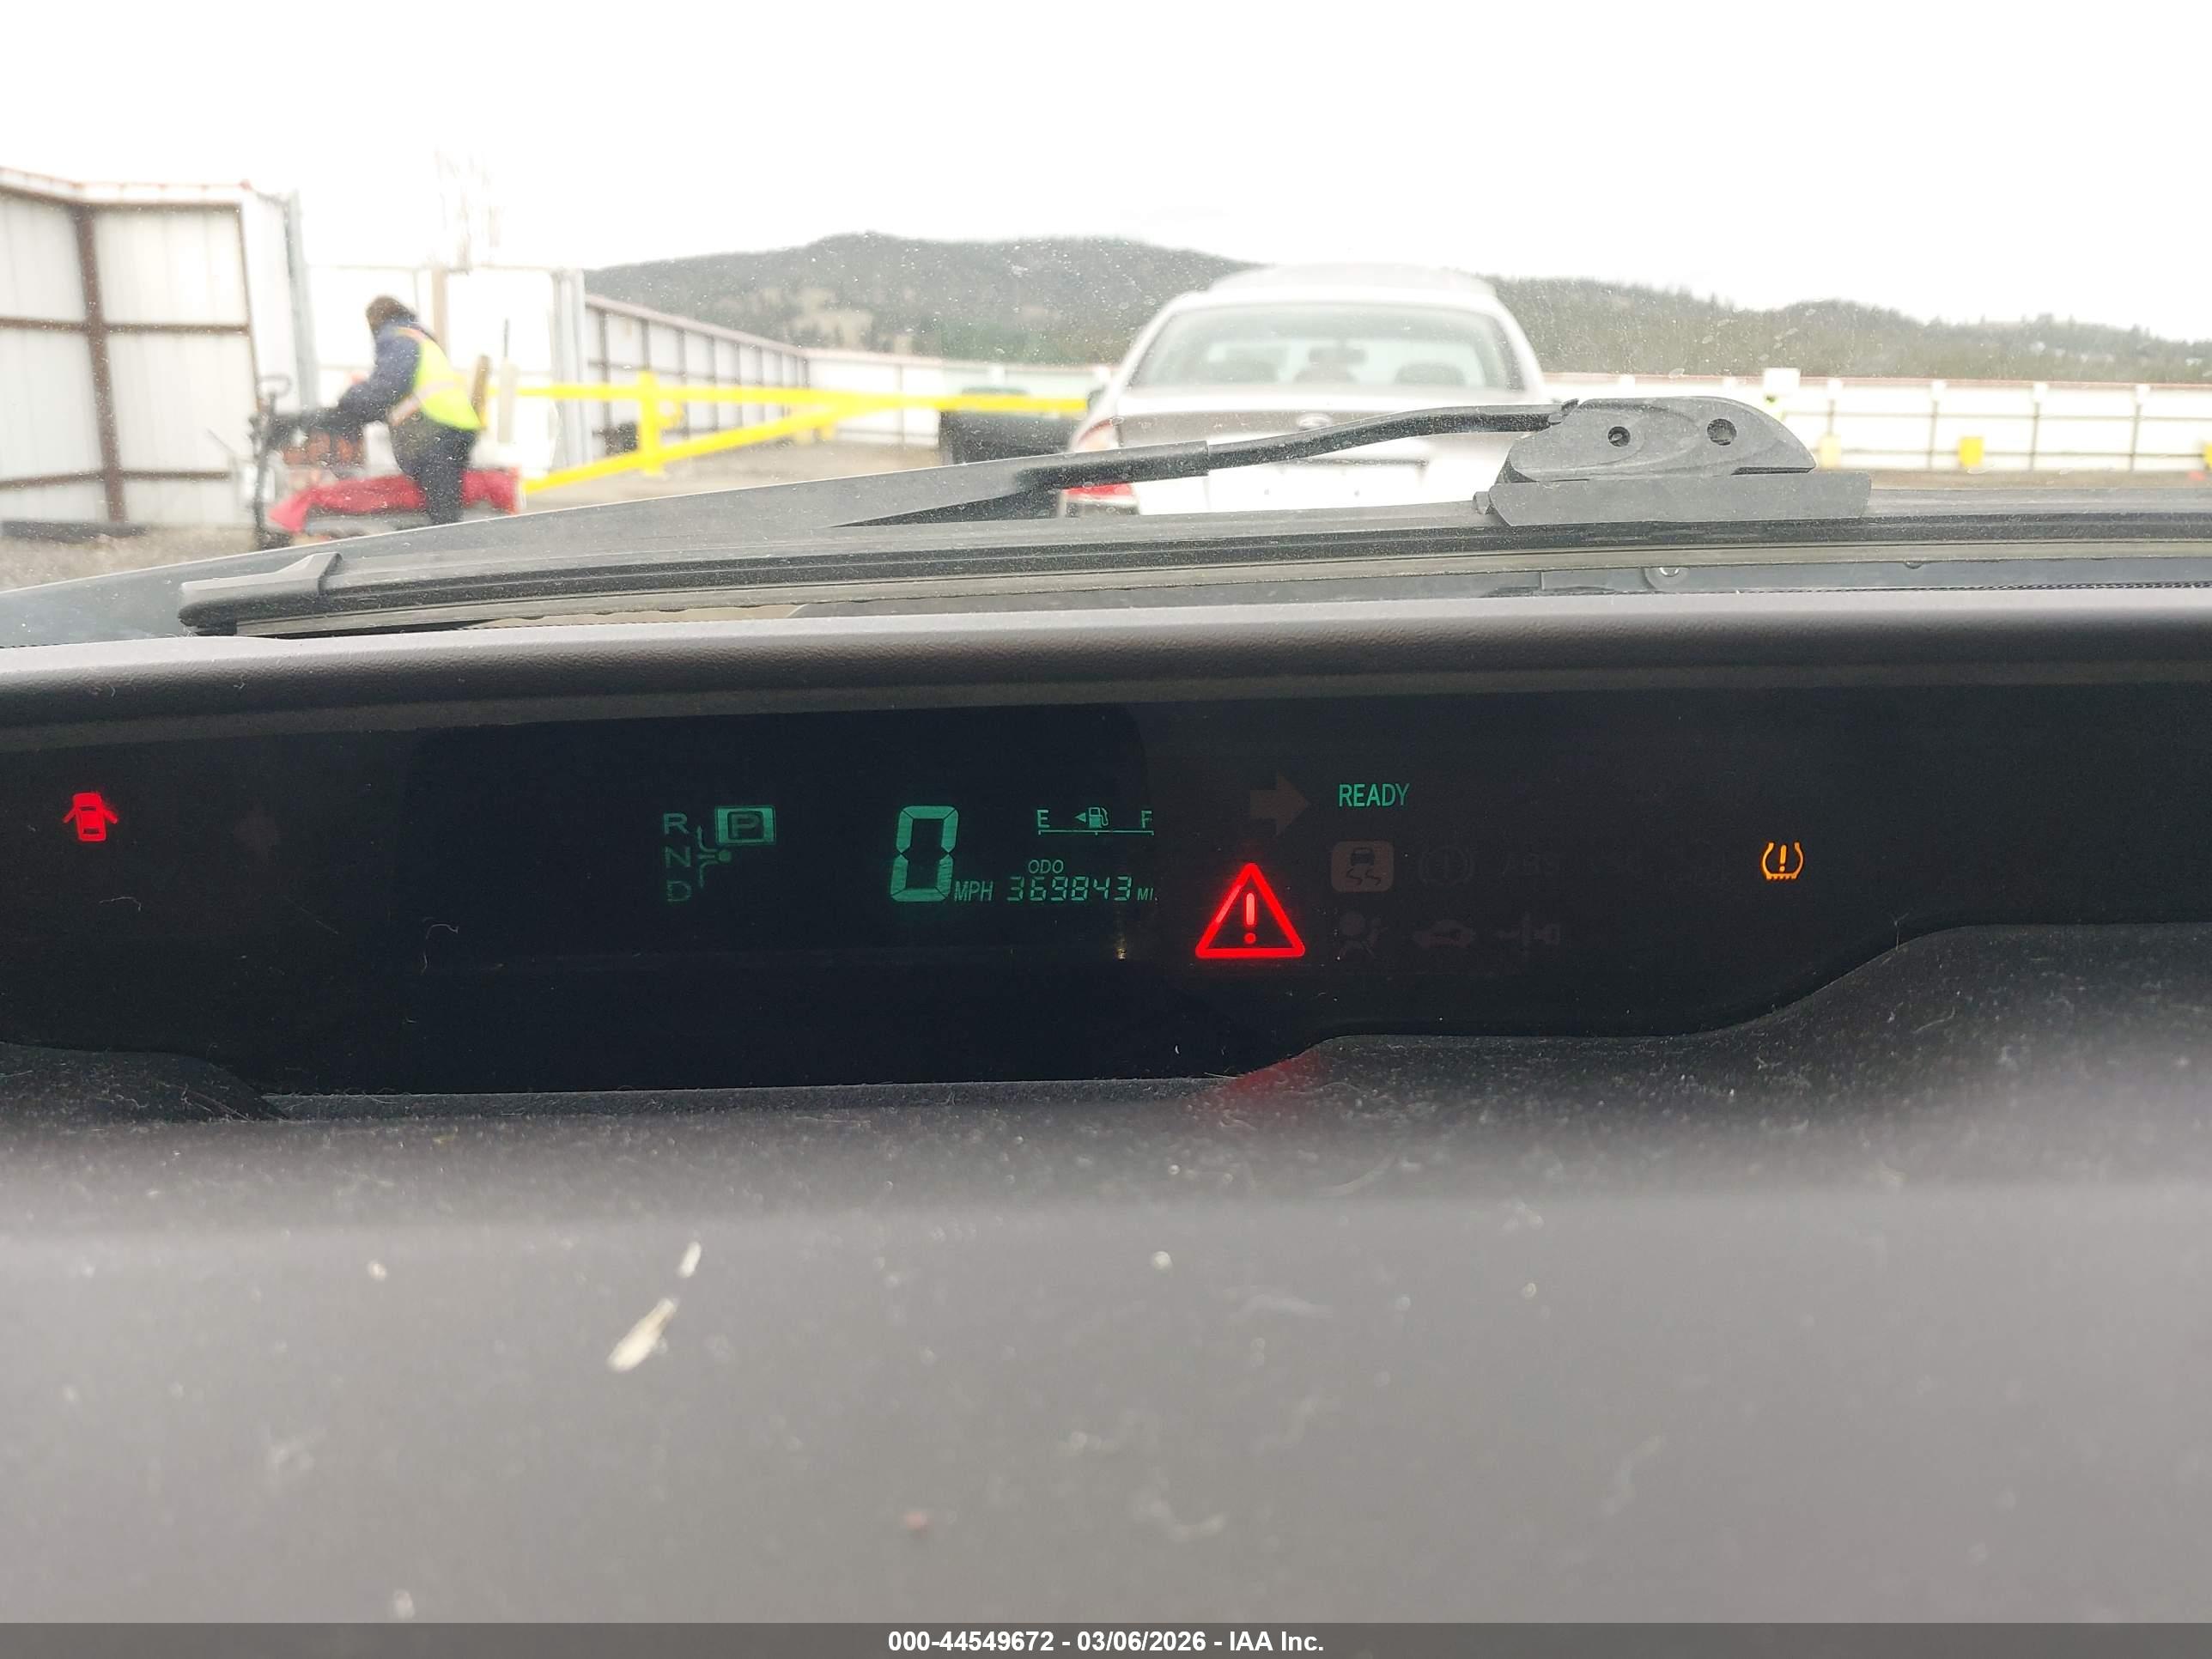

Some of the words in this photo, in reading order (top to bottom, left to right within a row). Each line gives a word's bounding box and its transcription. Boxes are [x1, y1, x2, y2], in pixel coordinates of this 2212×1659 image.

[1338, 782, 1411, 807] READY
[664, 812, 689, 835] R
[732, 815, 760, 838] P
[1036, 809, 1050, 829] E
[1141, 810, 1152, 829] F
[665, 847, 691, 867] N
[890, 805, 960, 902] 0
[953, 879, 994, 902] MPH
[1028, 859, 1065, 874] ODO
[666, 880, 692, 902] D
[1006, 876, 1133, 902] 369843
